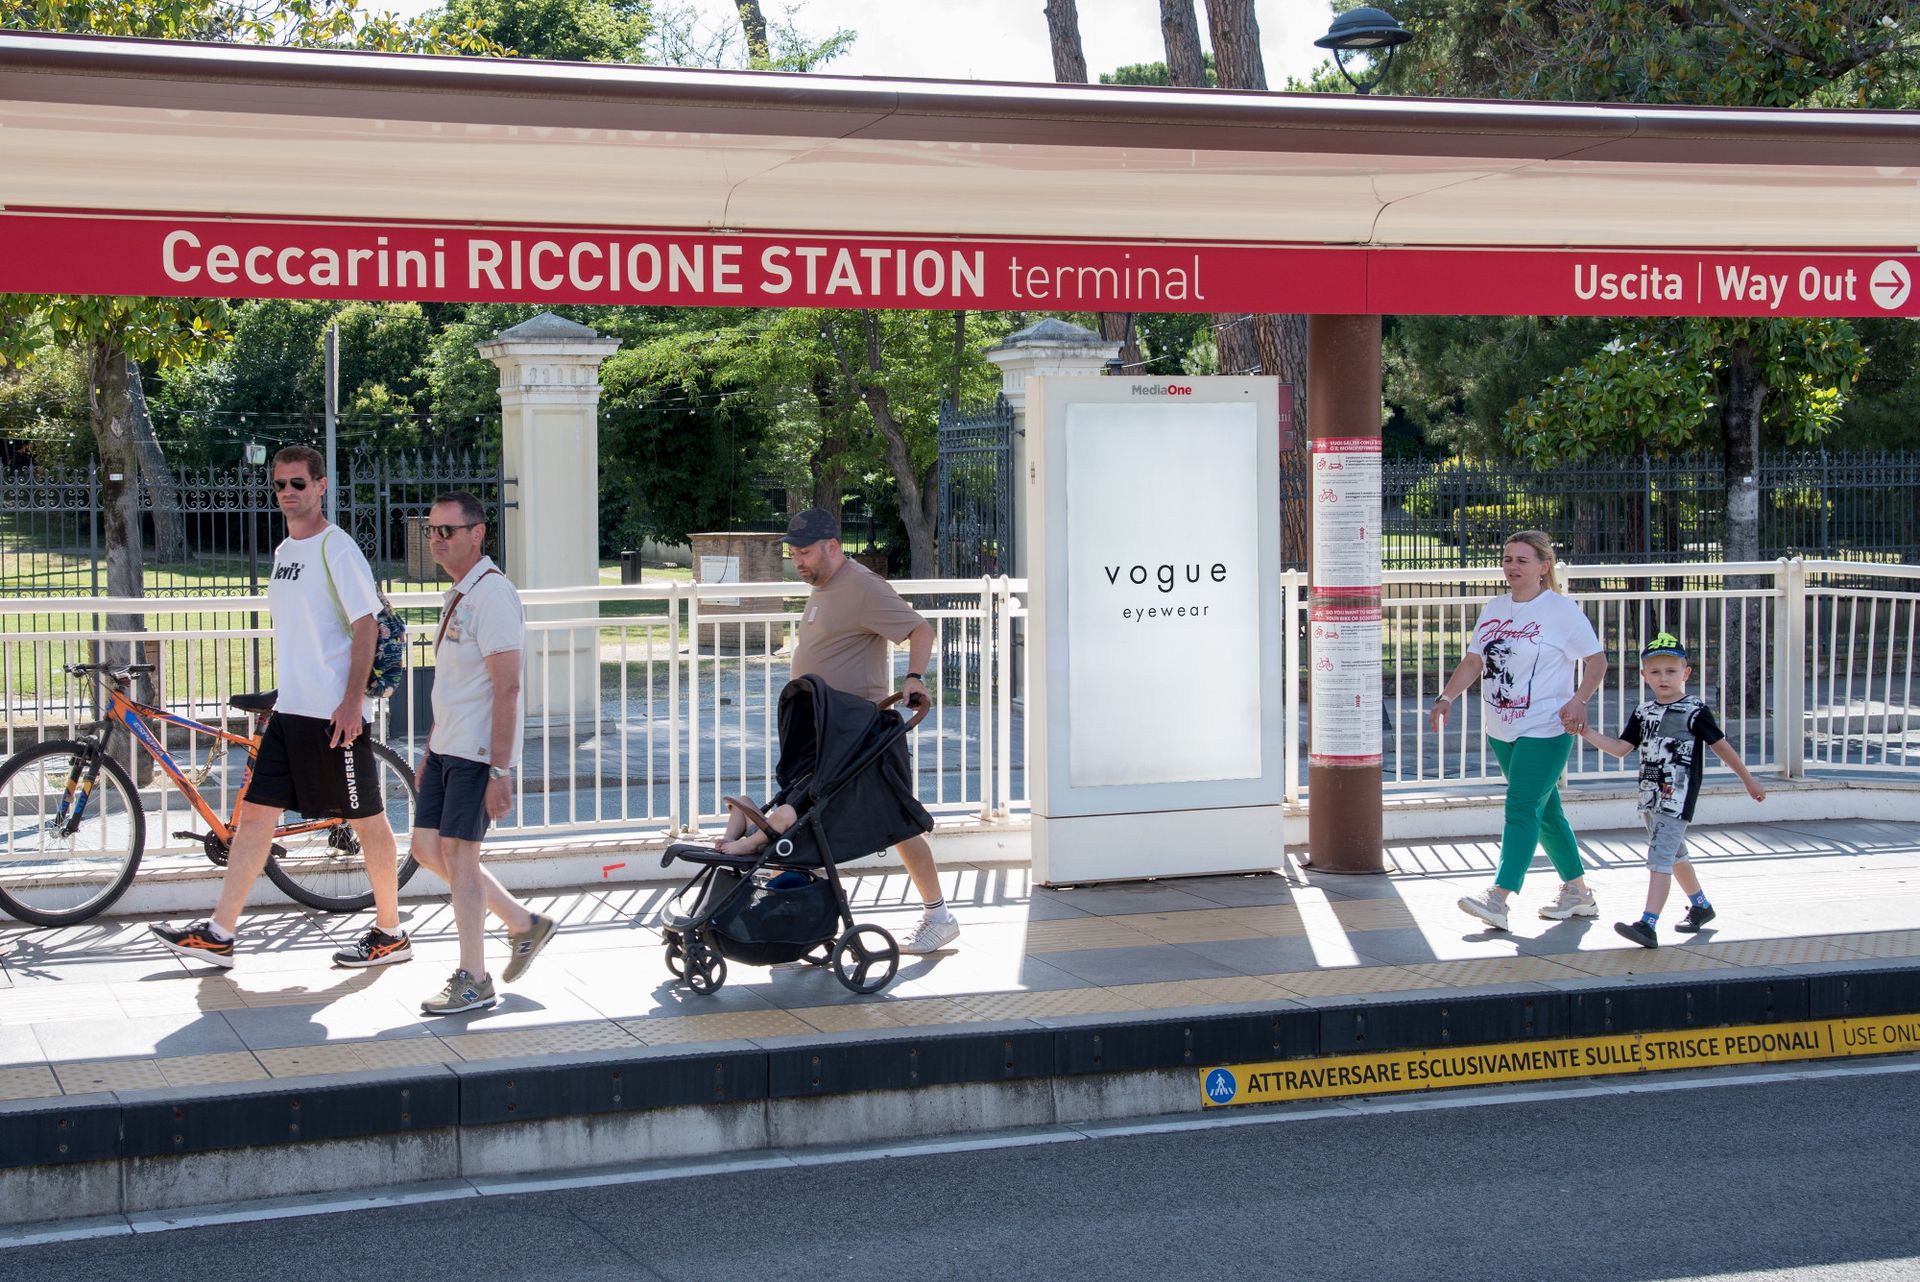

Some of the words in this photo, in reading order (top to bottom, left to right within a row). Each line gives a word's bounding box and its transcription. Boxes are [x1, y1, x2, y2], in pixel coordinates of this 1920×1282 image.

[162, 229, 446, 289] Ceccarini
[467, 238, 744, 294] RICCIONE
[759, 245, 985, 298] STATION
[1008, 252, 1206, 301] terminal
[1574, 264, 1683, 300] Uscita
[1715, 265, 1789, 310] Way
[1798, 266, 1857, 301] Out
[1131, 384, 1193, 396] MediaOne
[1104, 562, 1227, 593] vogue
[1122, 605, 1209, 623] eyewear
[344, 750, 360, 810] CONVERSE
[1843, 1027, 1878, 1046] USE
[1883, 1024, 1920, 1043] ONL
[1247, 1062, 1402, 1094] ATTRAVERSARE
[1407, 1048, 1581, 1081] ESCLUSIVAMENTE
[1585, 1043, 1642, 1066] SULLE
[1645, 1037, 1720, 1062] STRISCE
[1725, 1030, 1820, 1055] PEDONALI
